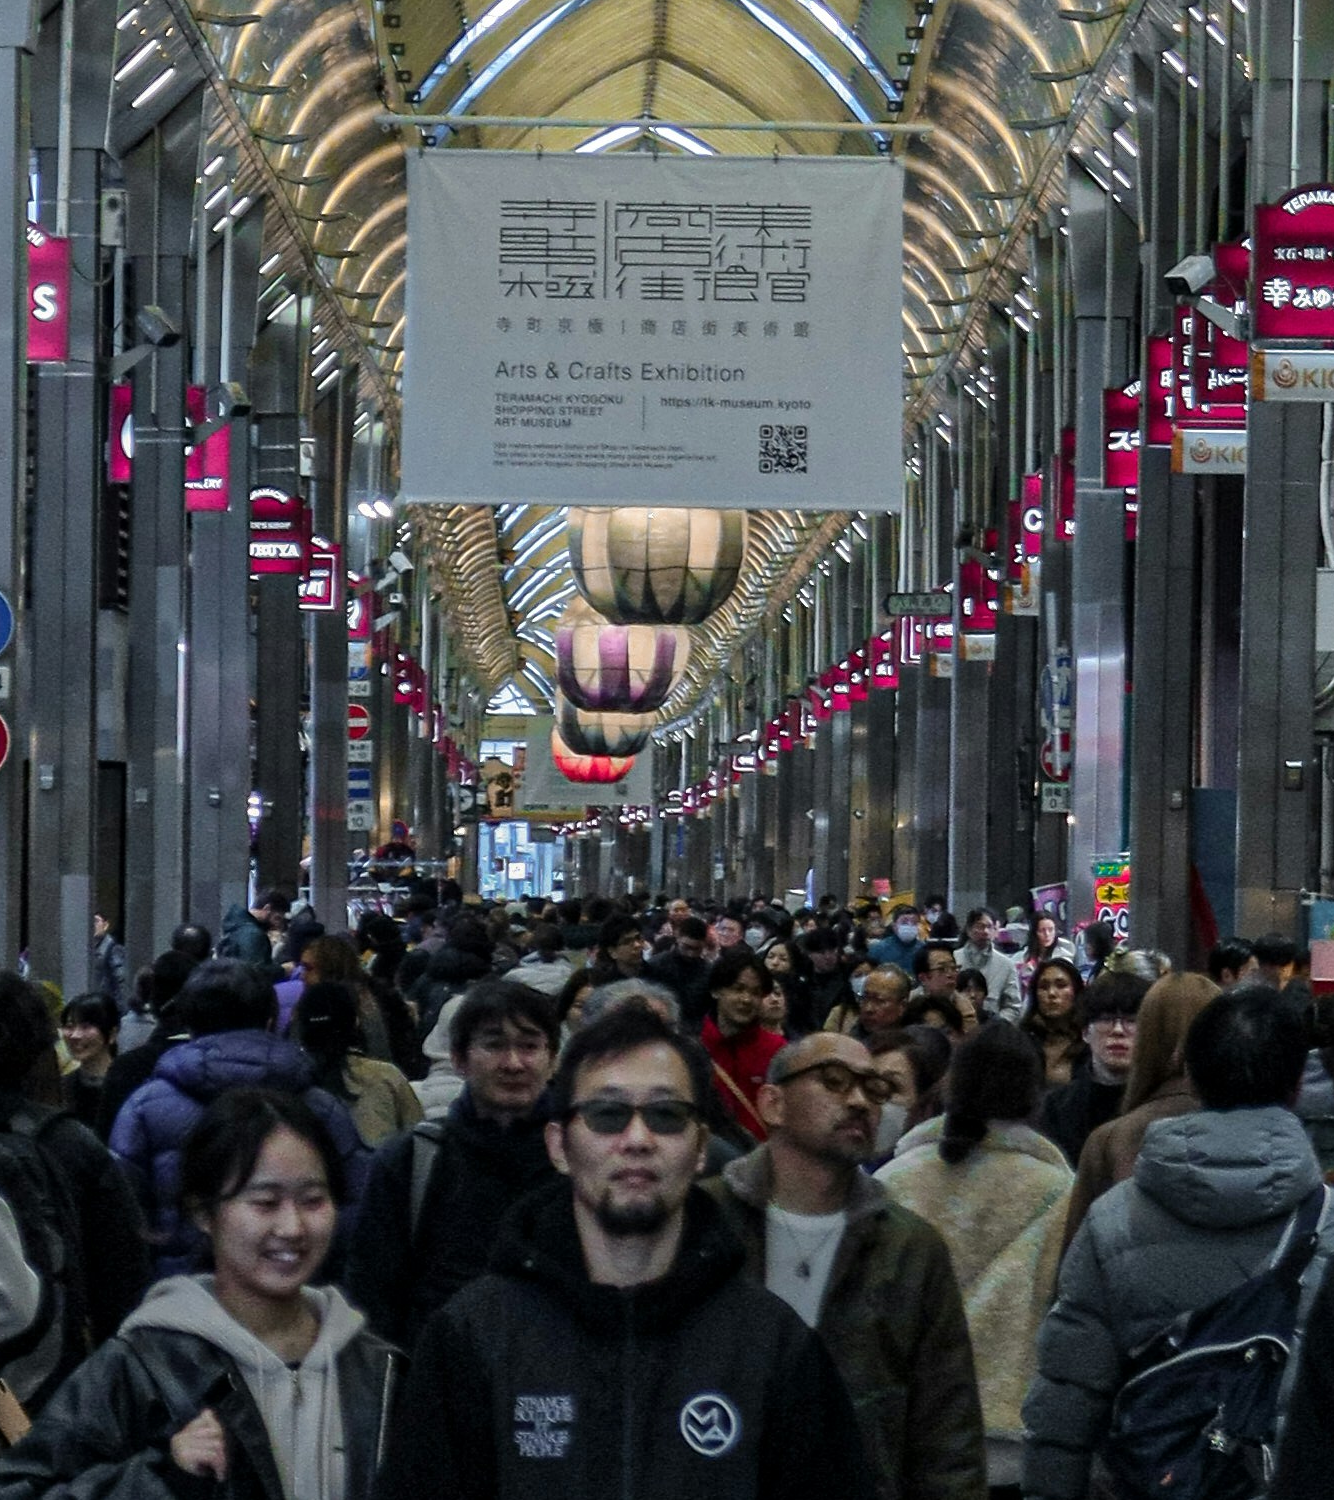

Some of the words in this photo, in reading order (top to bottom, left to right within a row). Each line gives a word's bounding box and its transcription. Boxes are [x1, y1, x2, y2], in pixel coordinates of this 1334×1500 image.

[495, 361, 537, 379] Arts
[545, 362, 559, 379] &
[568, 362, 633, 381] Crafts
[640, 363, 746, 382] Exhibition
[495, 405, 555, 416] SHOPPING
[558, 406, 603, 417] STREET
[520, 418, 572, 428] MUSEUM
